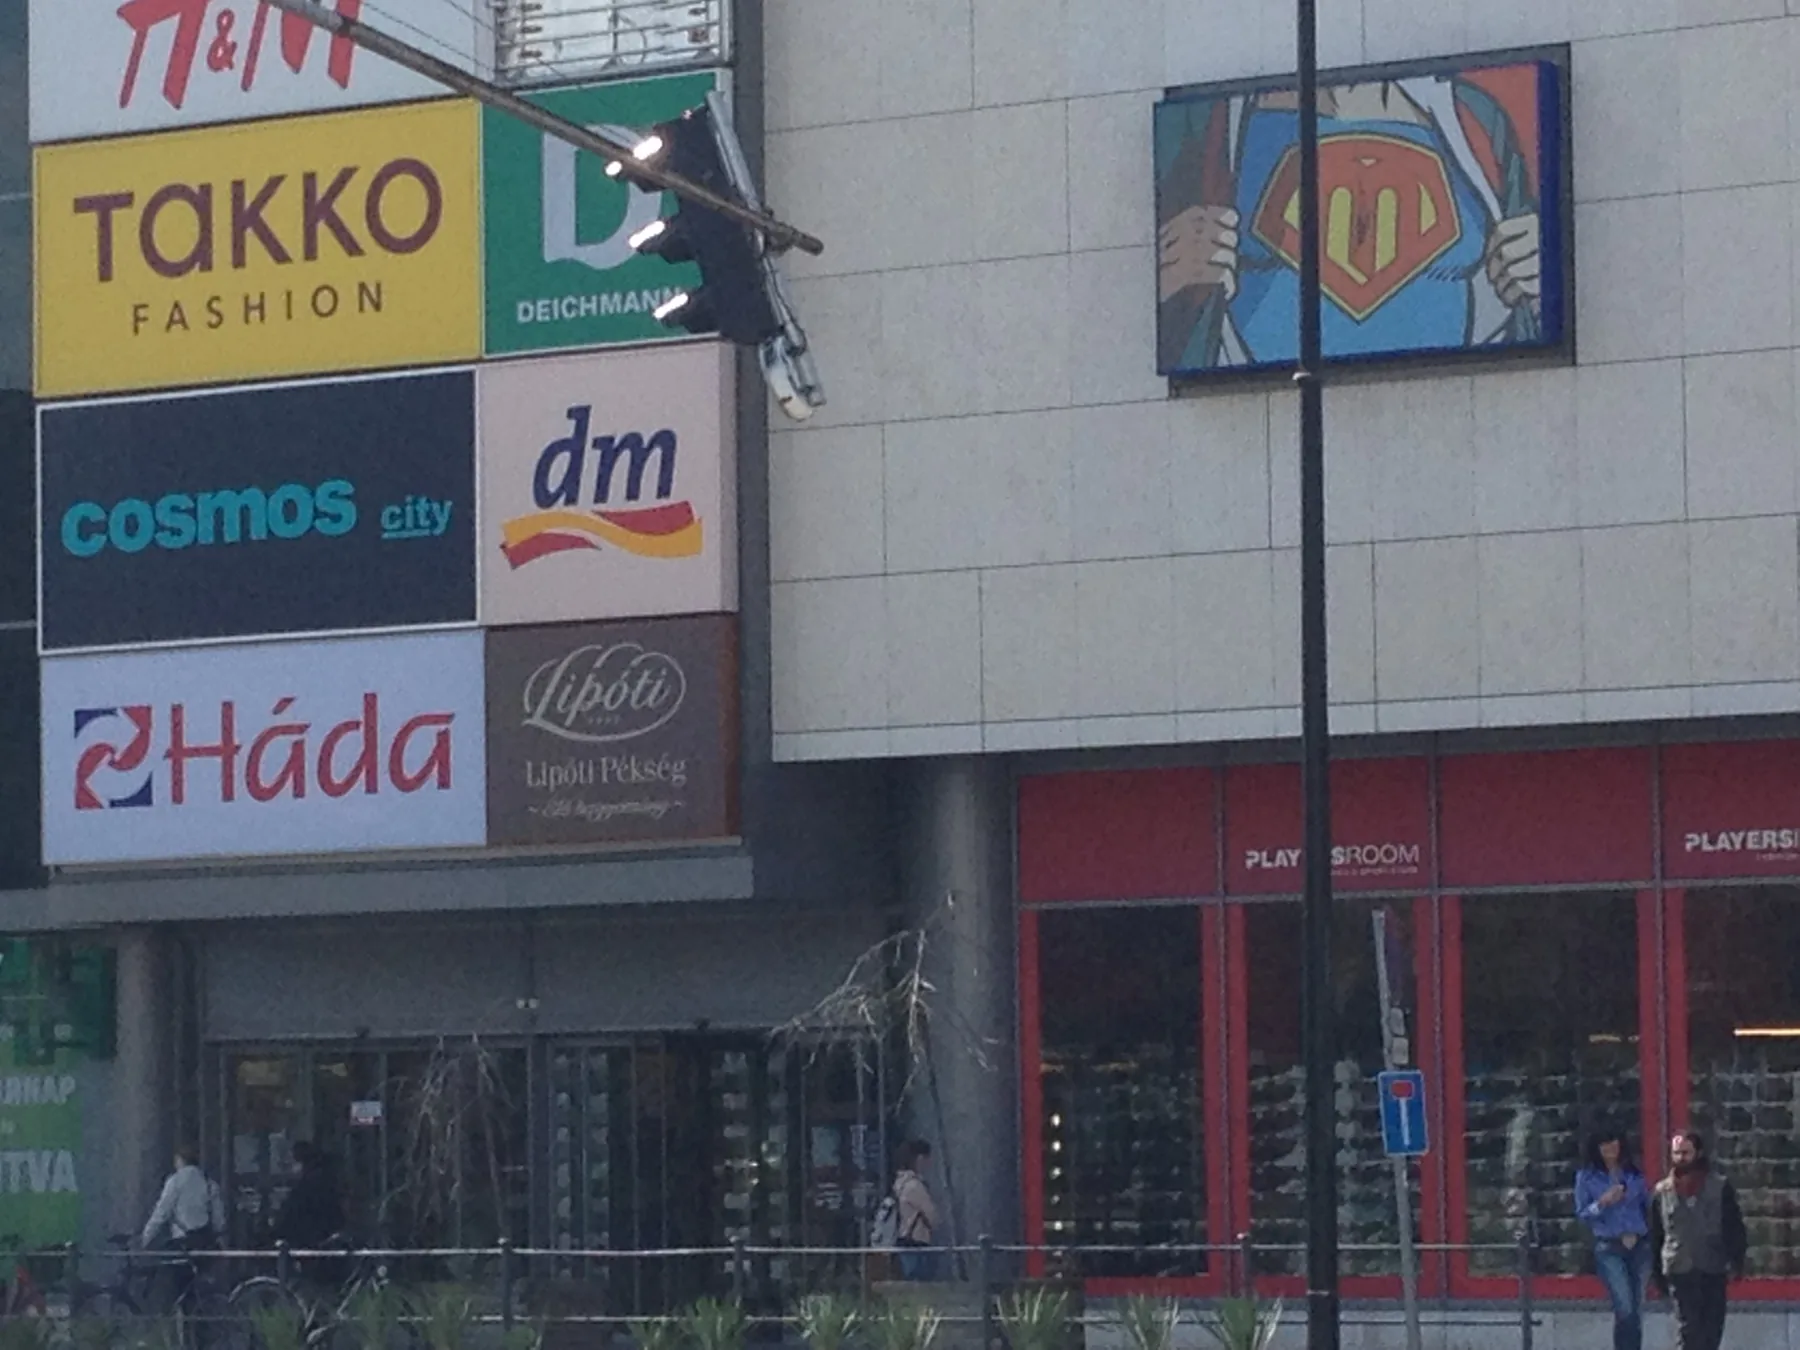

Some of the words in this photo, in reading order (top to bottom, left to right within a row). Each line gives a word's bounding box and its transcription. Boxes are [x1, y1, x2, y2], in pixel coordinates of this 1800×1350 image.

[133, 281, 384, 336] FASHION
[533, 404, 678, 509] dm
[61, 479, 357, 557] cosmos
[381, 495, 453, 538] city
[522, 643, 687, 742] Lipóti
[163, 692, 456, 805] Háda
[526, 757, 594, 793] Lipóti
[600, 752, 688, 787] Pékség
[1245, 843, 1420, 870] PLAYSROOM
